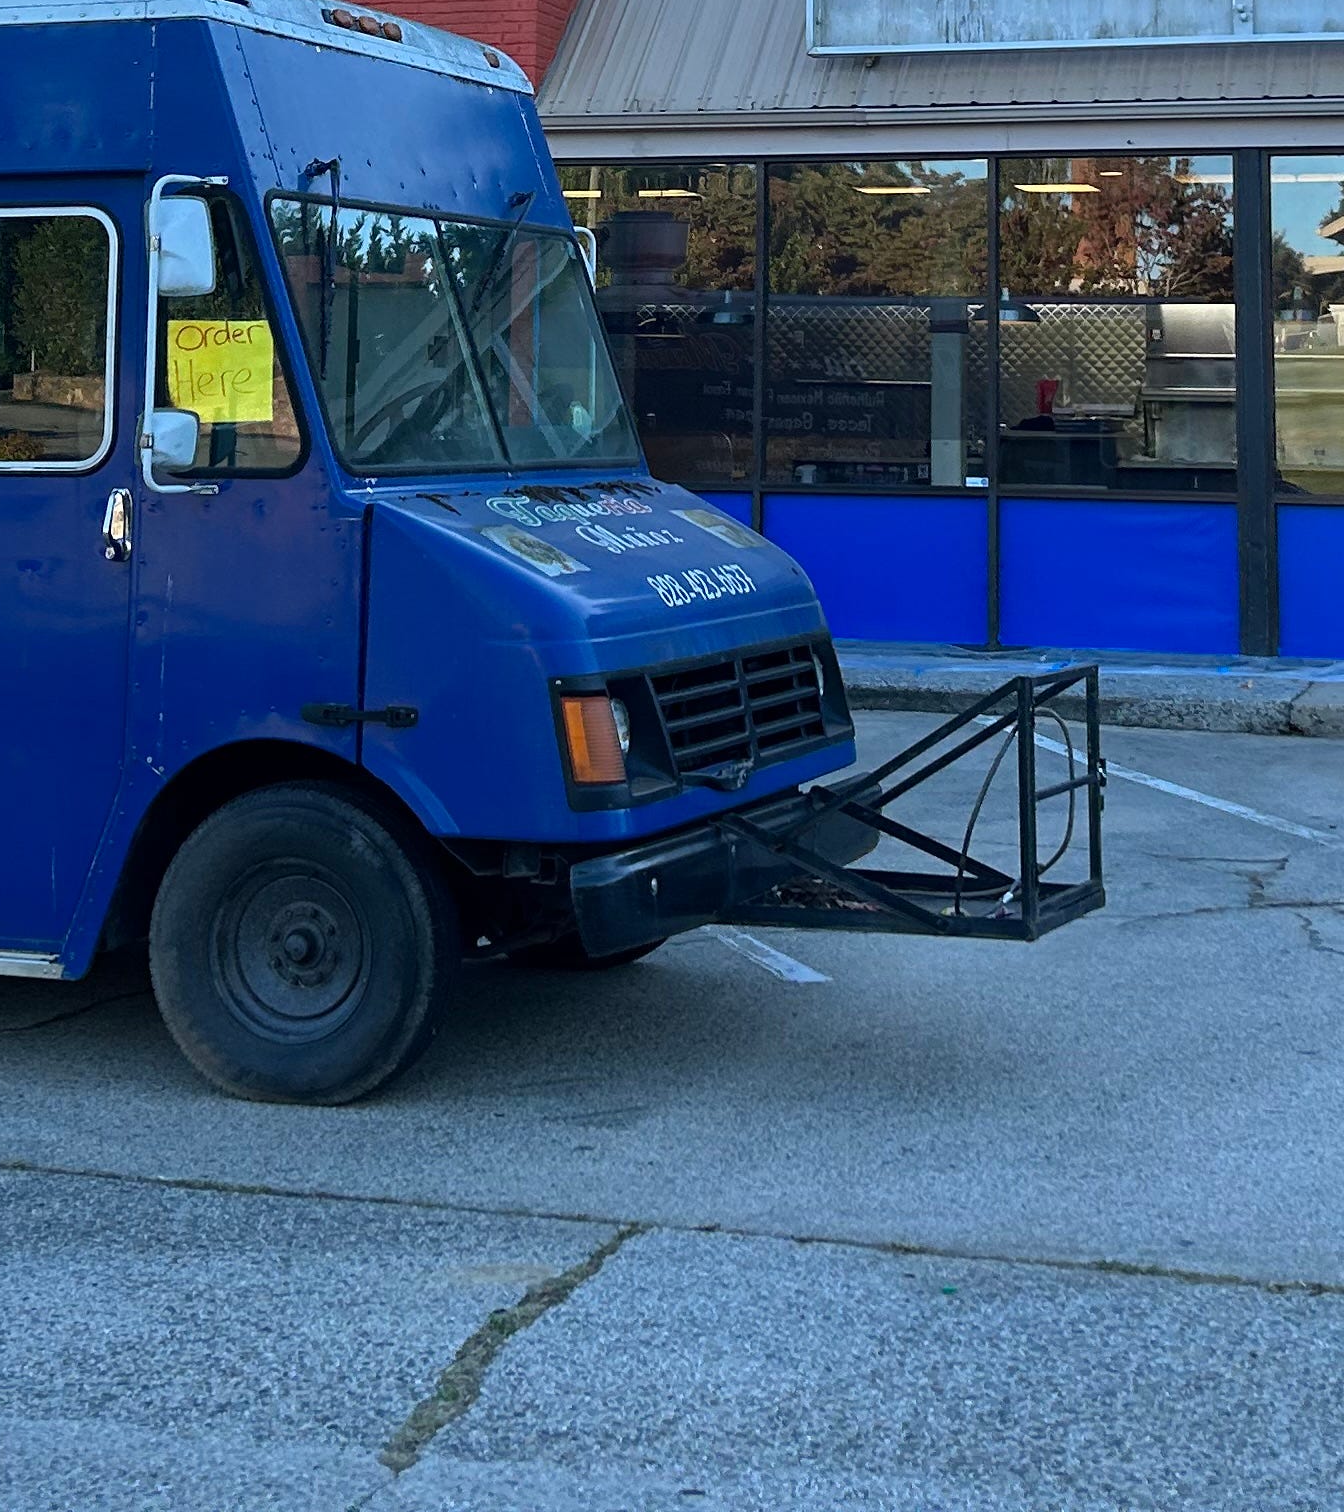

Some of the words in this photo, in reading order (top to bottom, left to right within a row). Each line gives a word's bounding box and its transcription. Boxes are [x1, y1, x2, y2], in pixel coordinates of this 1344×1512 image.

[176, 320, 264, 351] Order
[174, 359, 256, 403] Here
[485, 494, 654, 528] Taqueria
[646, 563, 757, 609] 828-423-6637
